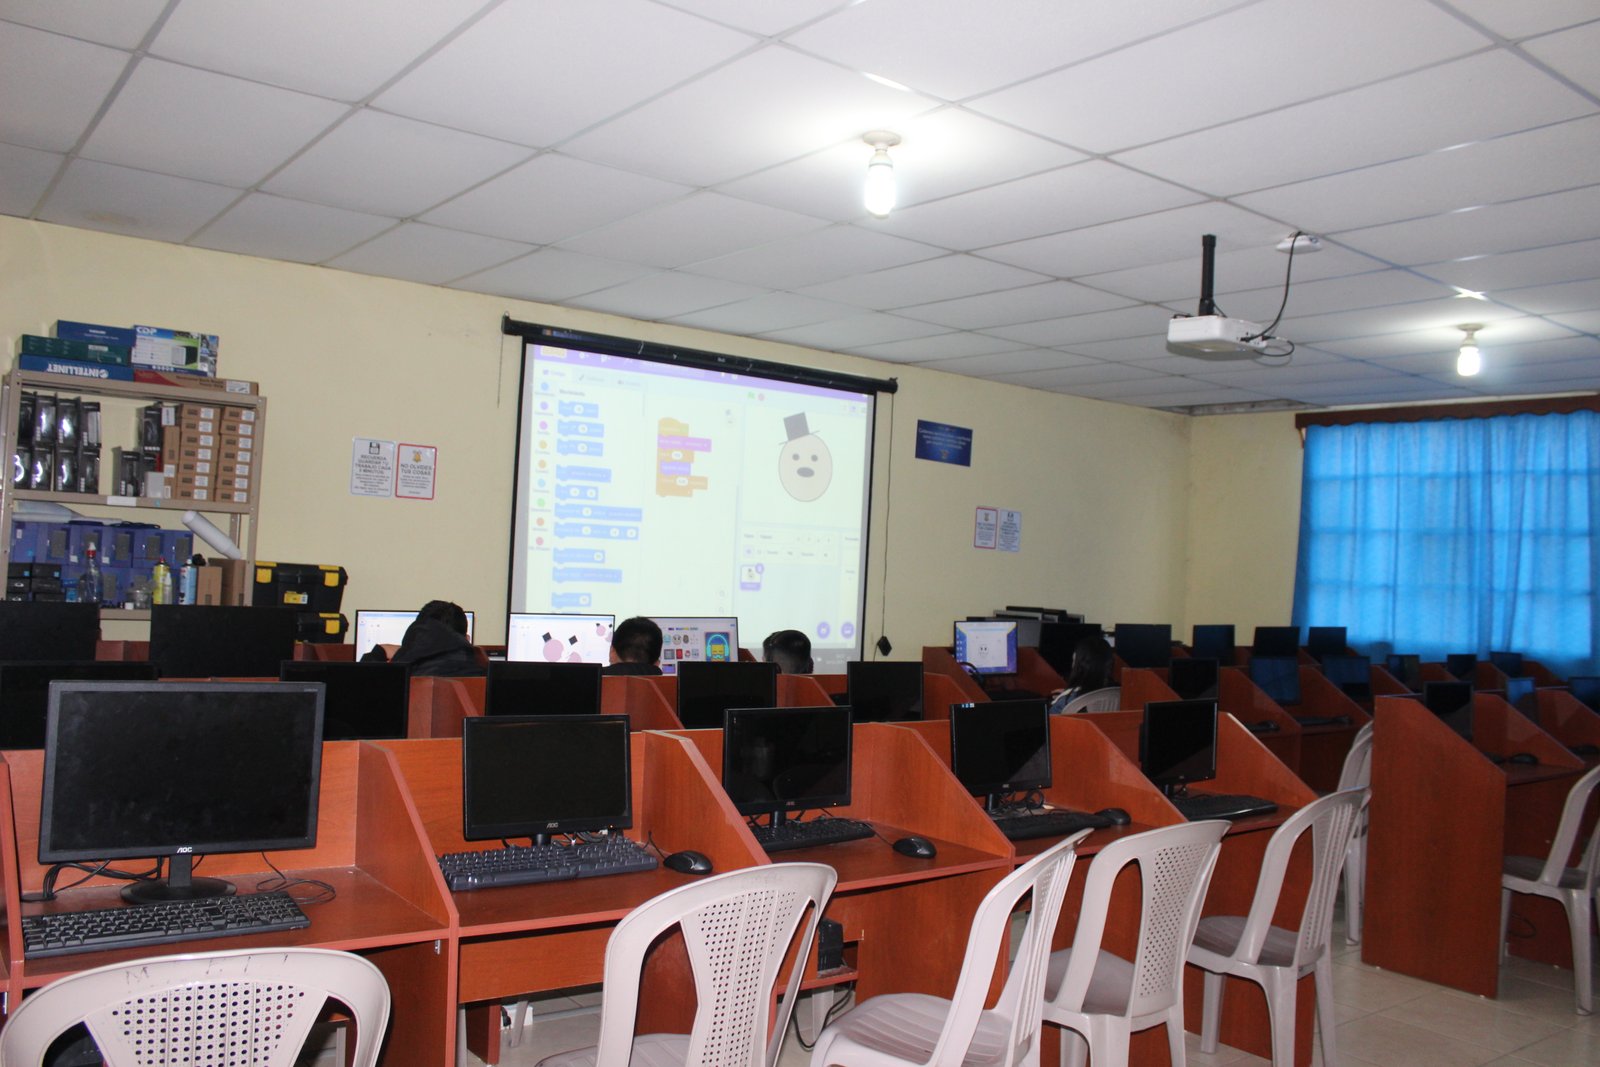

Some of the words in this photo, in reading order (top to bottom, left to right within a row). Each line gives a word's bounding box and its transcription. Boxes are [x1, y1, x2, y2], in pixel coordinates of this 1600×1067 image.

[136, 326, 157, 335] CDP
[47, 363, 99, 378] INTELLINET
[176, 846, 193, 854] AOC
